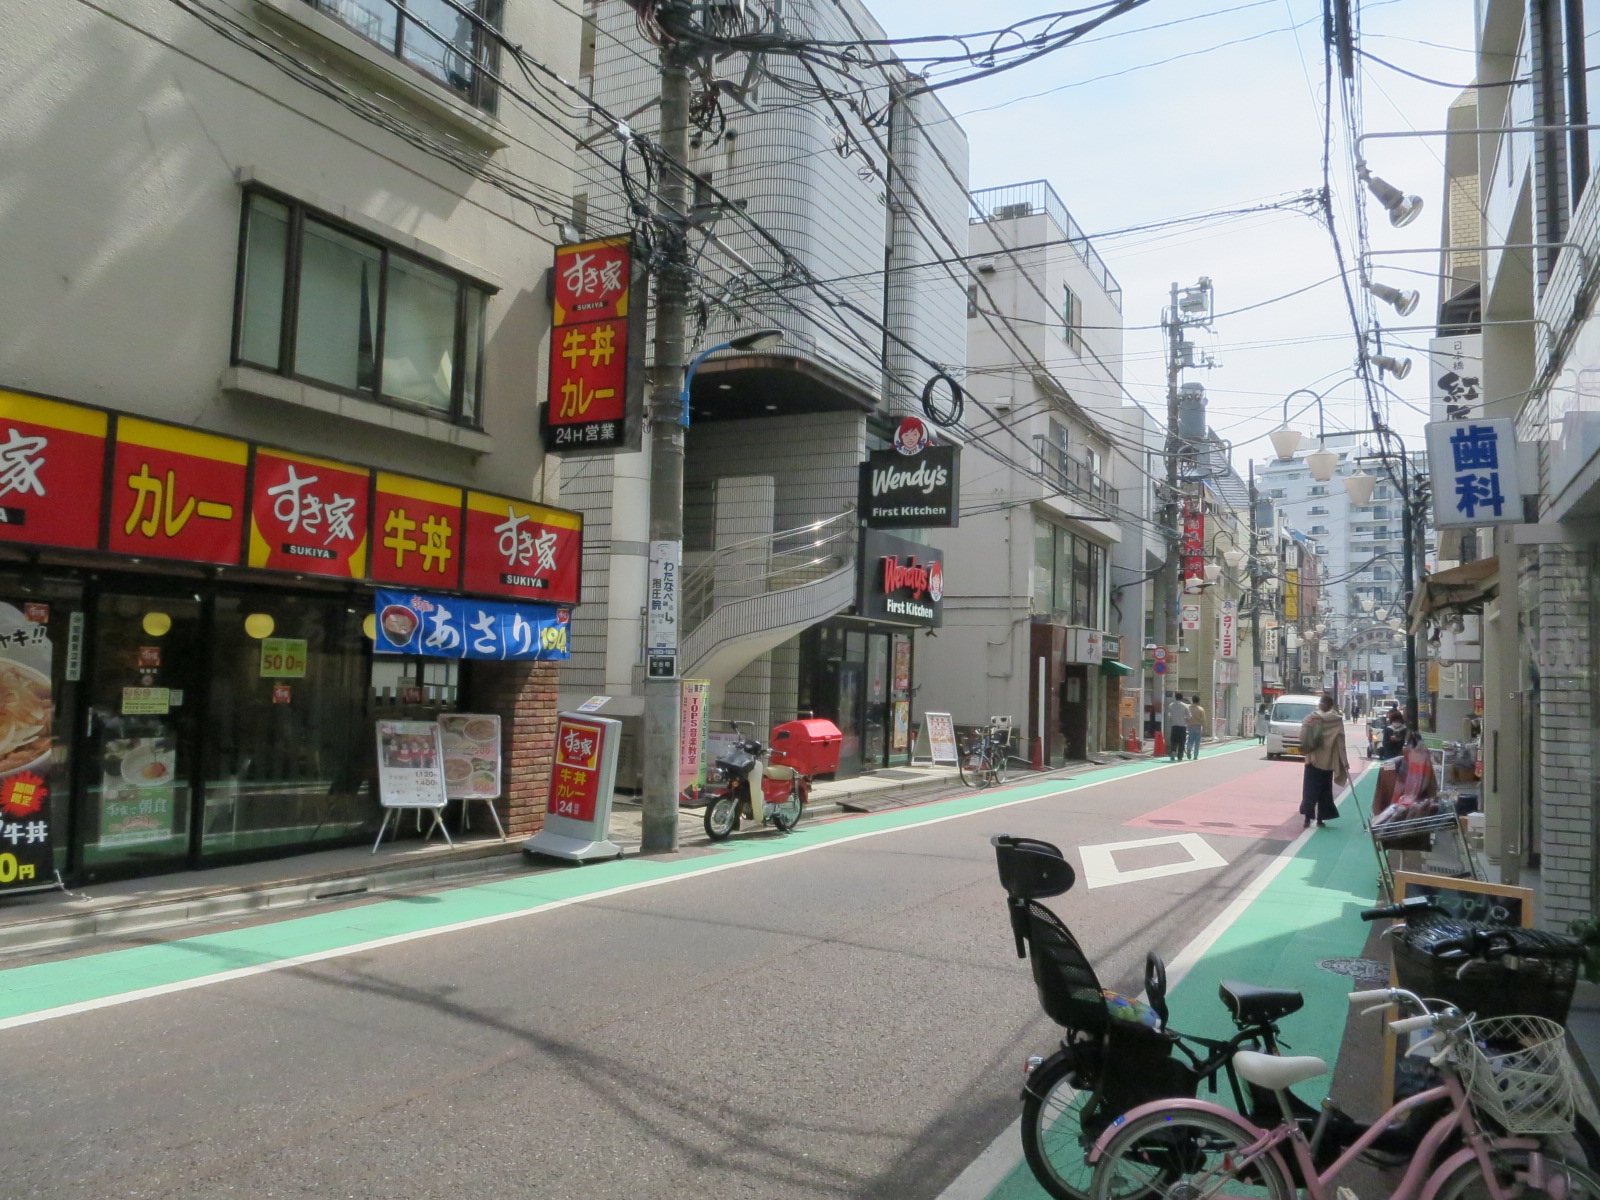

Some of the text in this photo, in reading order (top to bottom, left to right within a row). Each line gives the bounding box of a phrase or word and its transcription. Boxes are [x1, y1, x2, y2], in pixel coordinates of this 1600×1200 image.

[562, 252, 623, 299] すき家
[577, 301, 605, 311] SUKIYA
[562, 323, 616, 370] 牛丼
[559, 376, 616, 418] カレー
[555, 422, 616, 444] 24H営業
[872, 460, 948, 497] Wendy's
[1450, 424, 1505, 519] 歯科
[124, 462, 234, 539] カレー
[267, 464, 356, 546] すき家
[872, 506, 947, 517] First Kitchen
[289, 545, 331, 559] SUKIYA
[383, 508, 453, 574] 牛丼
[493, 504, 559, 577] すき家
[506, 574, 544, 589] SUKIYA
[663, 561, 675, 602] わたなべ
[882, 554, 928, 600] Wendy's
[886, 598, 934, 619] First Kitchen
[425, 604, 533, 656] あさり
[1221, 615, 1232, 657] クリーニング
[563, 728, 593, 757] すき家
[687, 697, 699, 765] TOPS音楽教室
[557, 783, 586, 798] カレー
[560, 767, 587, 786] 牛丼
